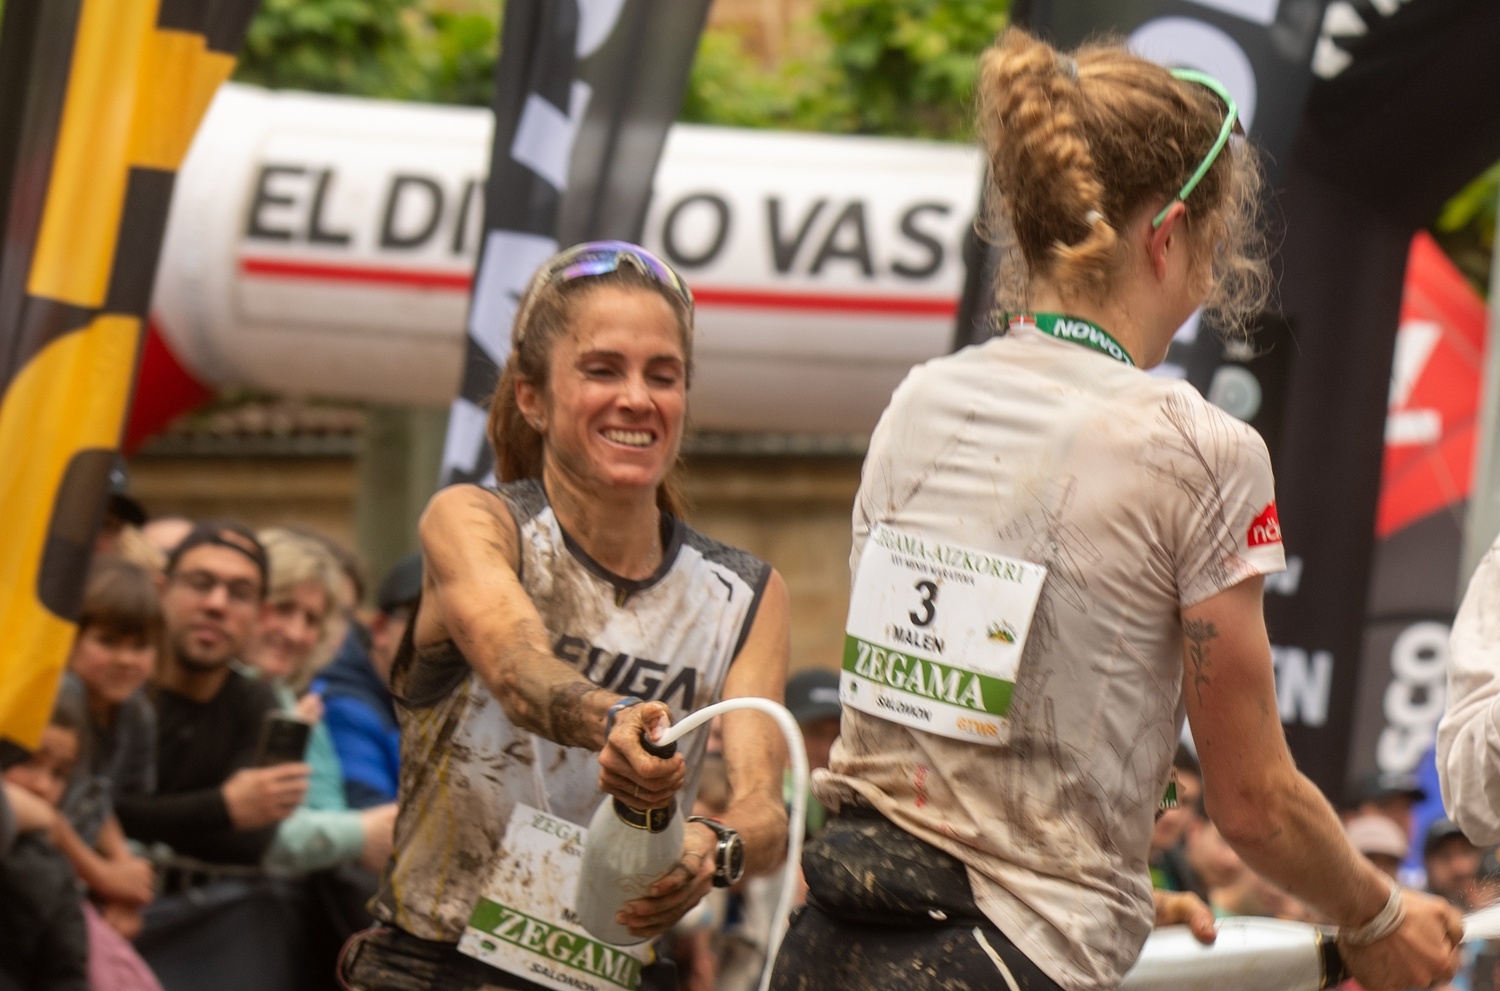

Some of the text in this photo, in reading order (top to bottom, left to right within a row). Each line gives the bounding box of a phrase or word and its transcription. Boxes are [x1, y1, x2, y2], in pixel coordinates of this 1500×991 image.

[246, 163, 968, 280] EL DIO VAS
[909, 581, 939, 627] 3
[891, 622, 945, 655] MALEN
[854, 639, 988, 712] ZEGAMA
